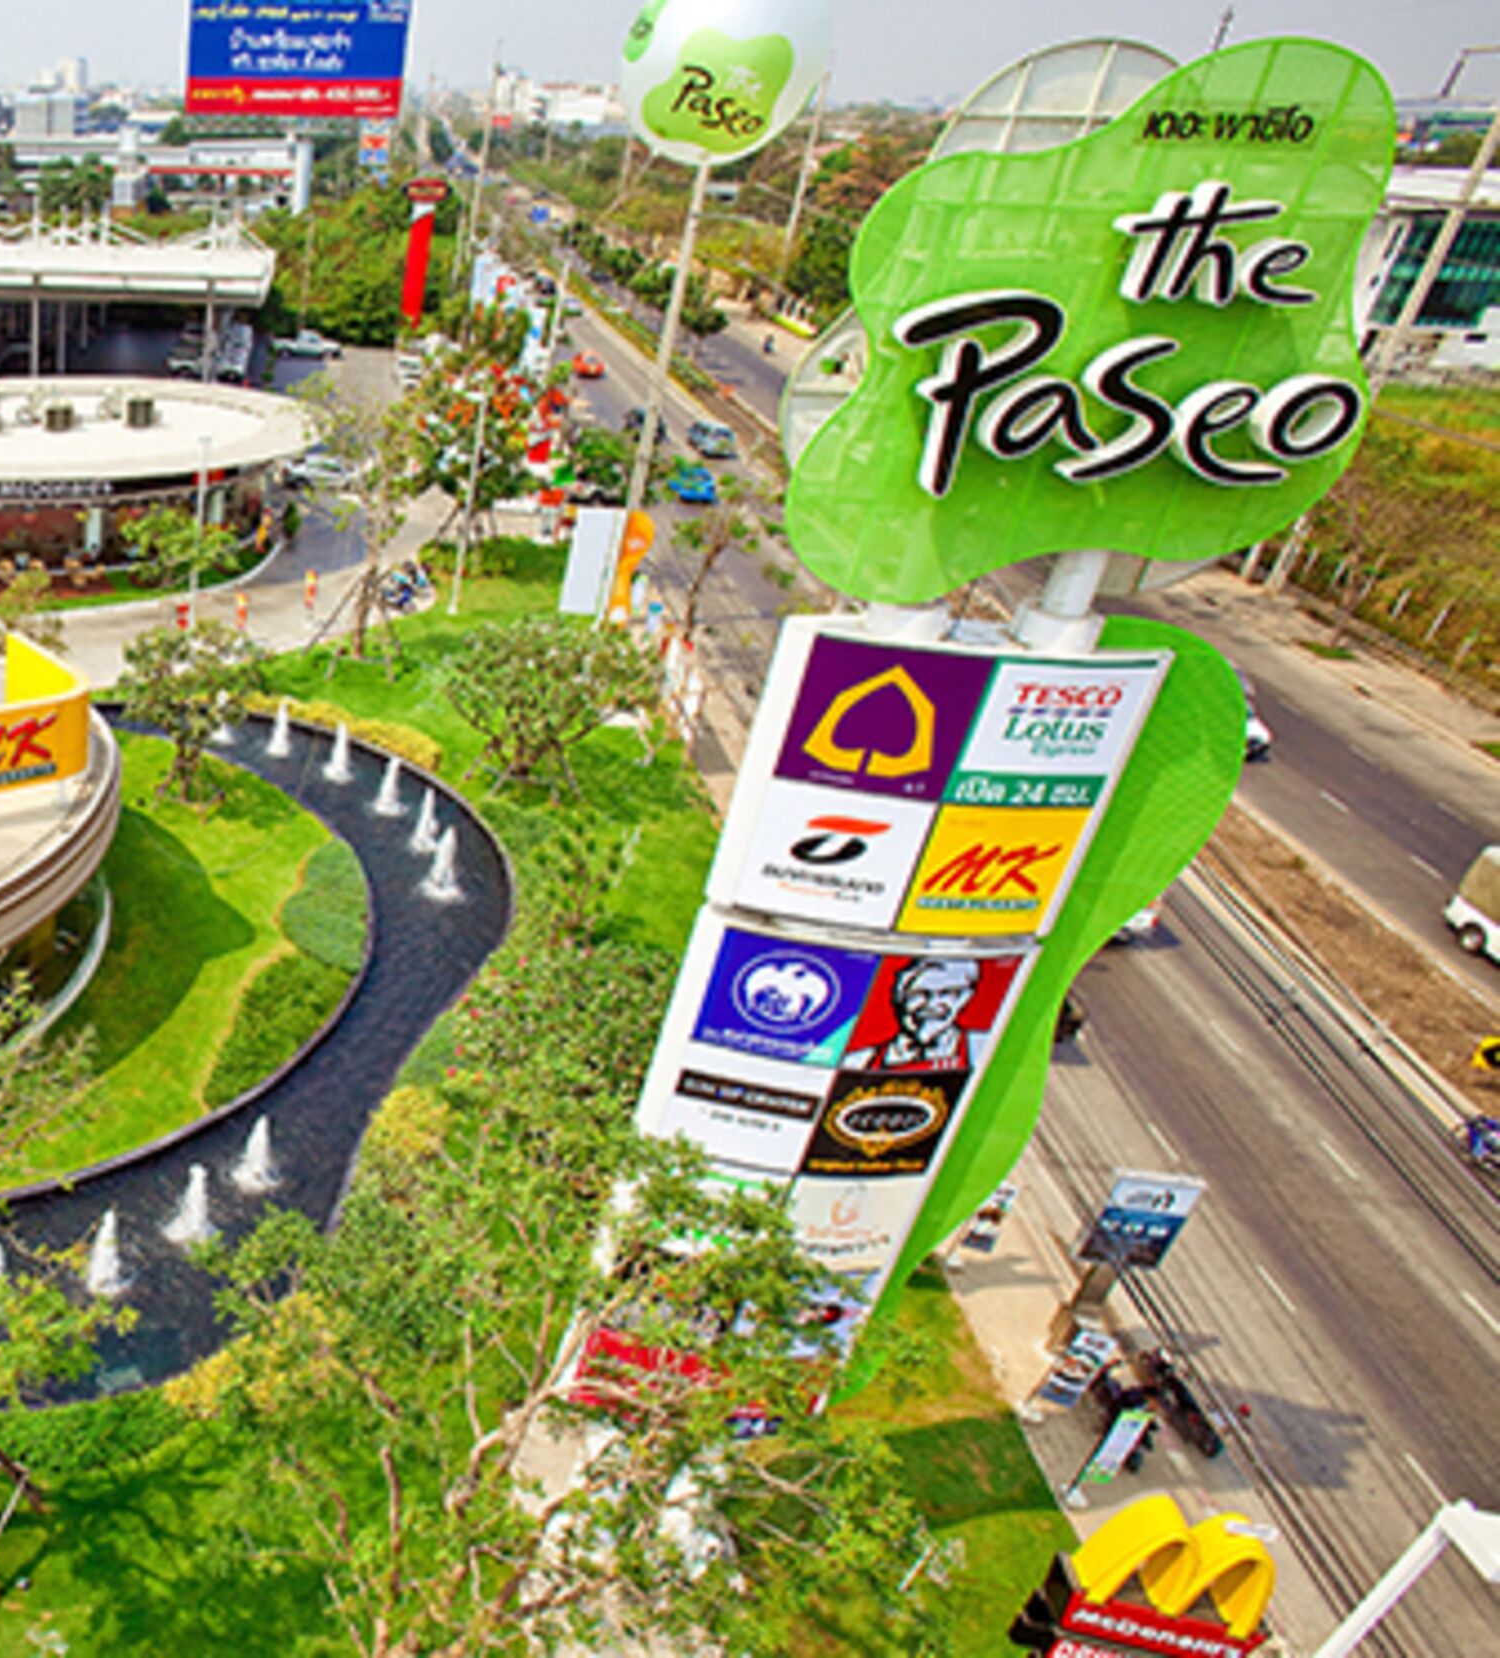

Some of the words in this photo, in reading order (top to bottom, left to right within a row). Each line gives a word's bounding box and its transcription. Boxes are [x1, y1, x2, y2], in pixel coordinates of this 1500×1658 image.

[670, 64, 765, 139] Paseo
[1114, 181, 1316, 306] the
[894, 290, 1363, 497] Paseo
[1012, 682, 1124, 708] TESCO
[1003, 715, 1108, 741] Lotus
[1010, 781, 1048, 804] 24
[923, 843, 1064, 896] MK
